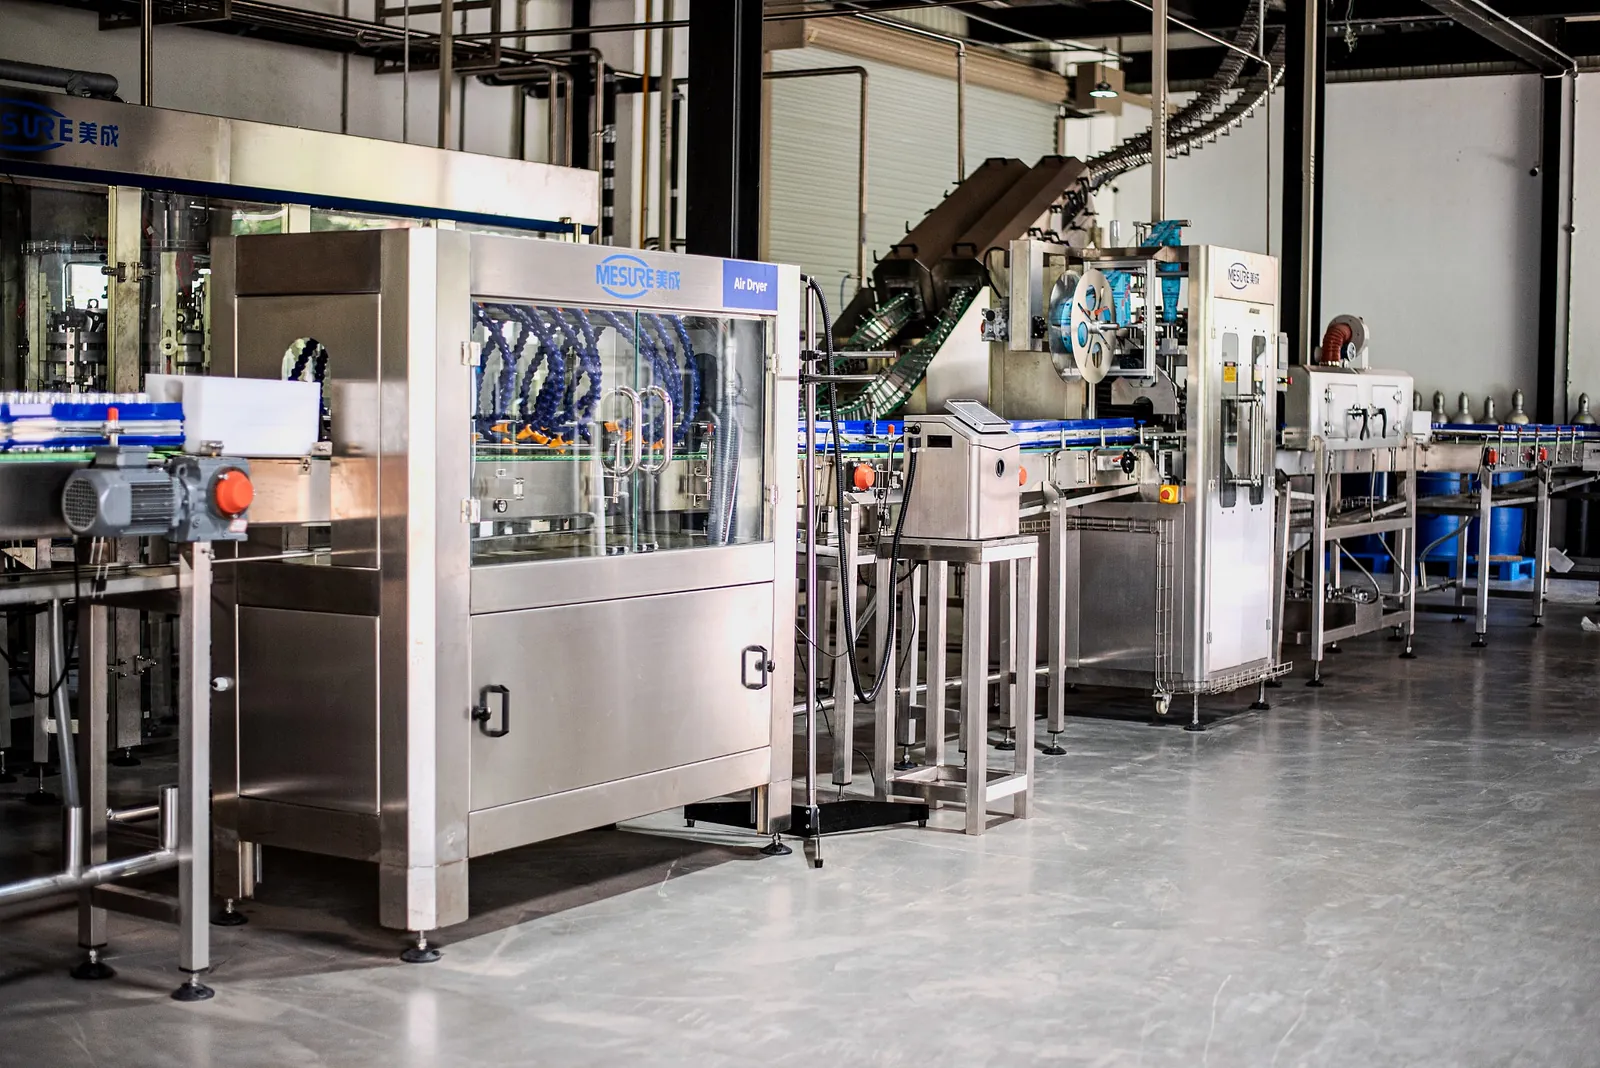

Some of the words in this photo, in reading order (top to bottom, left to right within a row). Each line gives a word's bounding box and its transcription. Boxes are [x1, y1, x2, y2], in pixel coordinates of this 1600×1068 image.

[79, 121, 119, 147] 美成
[596, 264, 654, 288] MESURE
[656, 270, 680, 290] 美成
[733, 277, 746, 290] Air
[747, 278, 768, 294] Dryer
[1228, 269, 1249, 283] MESURE
